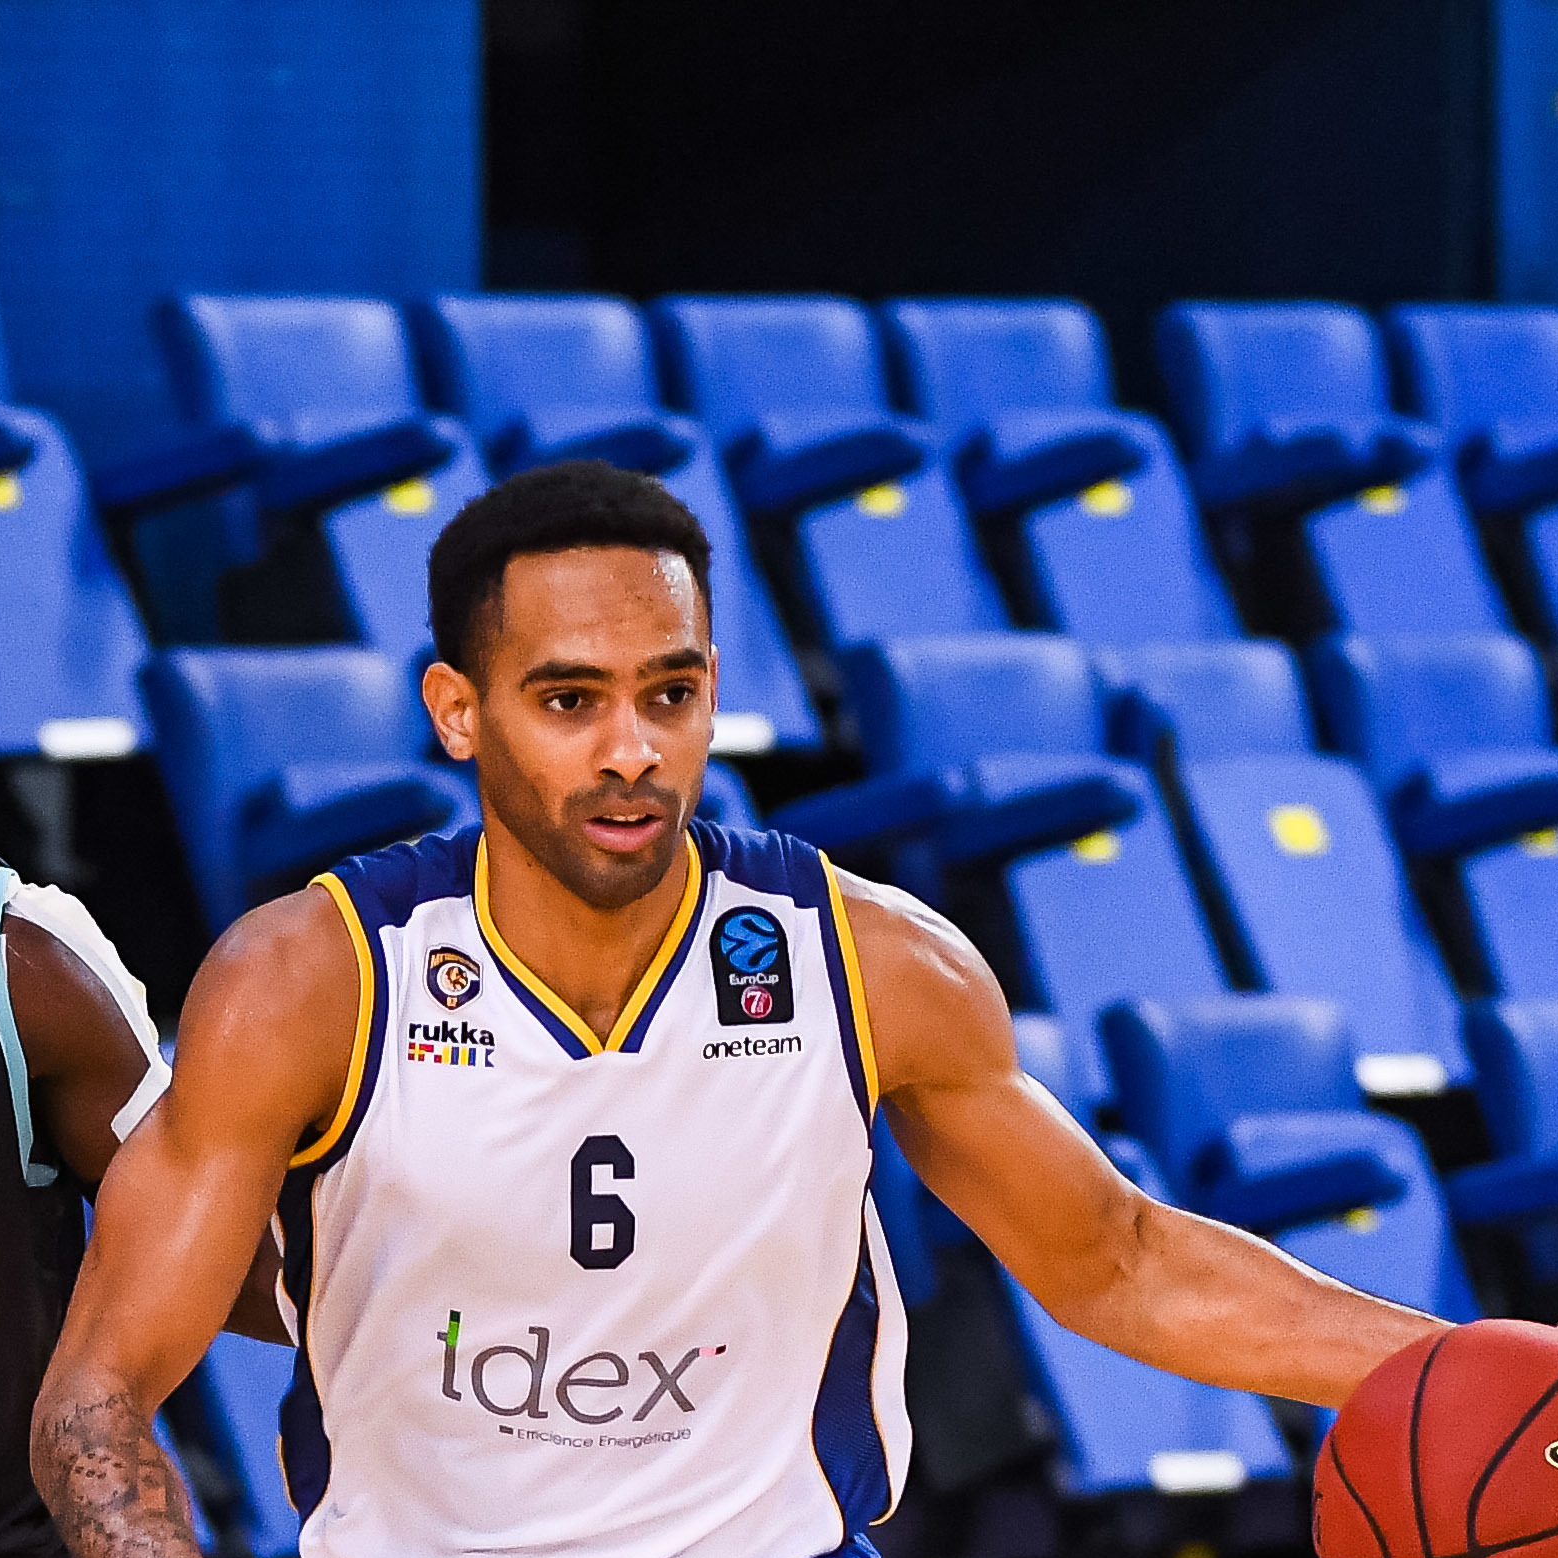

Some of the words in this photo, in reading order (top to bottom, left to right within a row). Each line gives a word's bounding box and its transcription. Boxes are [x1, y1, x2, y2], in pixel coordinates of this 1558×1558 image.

[729, 973, 780, 986] EuroCup
[408, 1021, 495, 1046] rukka
[703, 1035, 802, 1060] oneteam
[570, 1135, 635, 1270] 6
